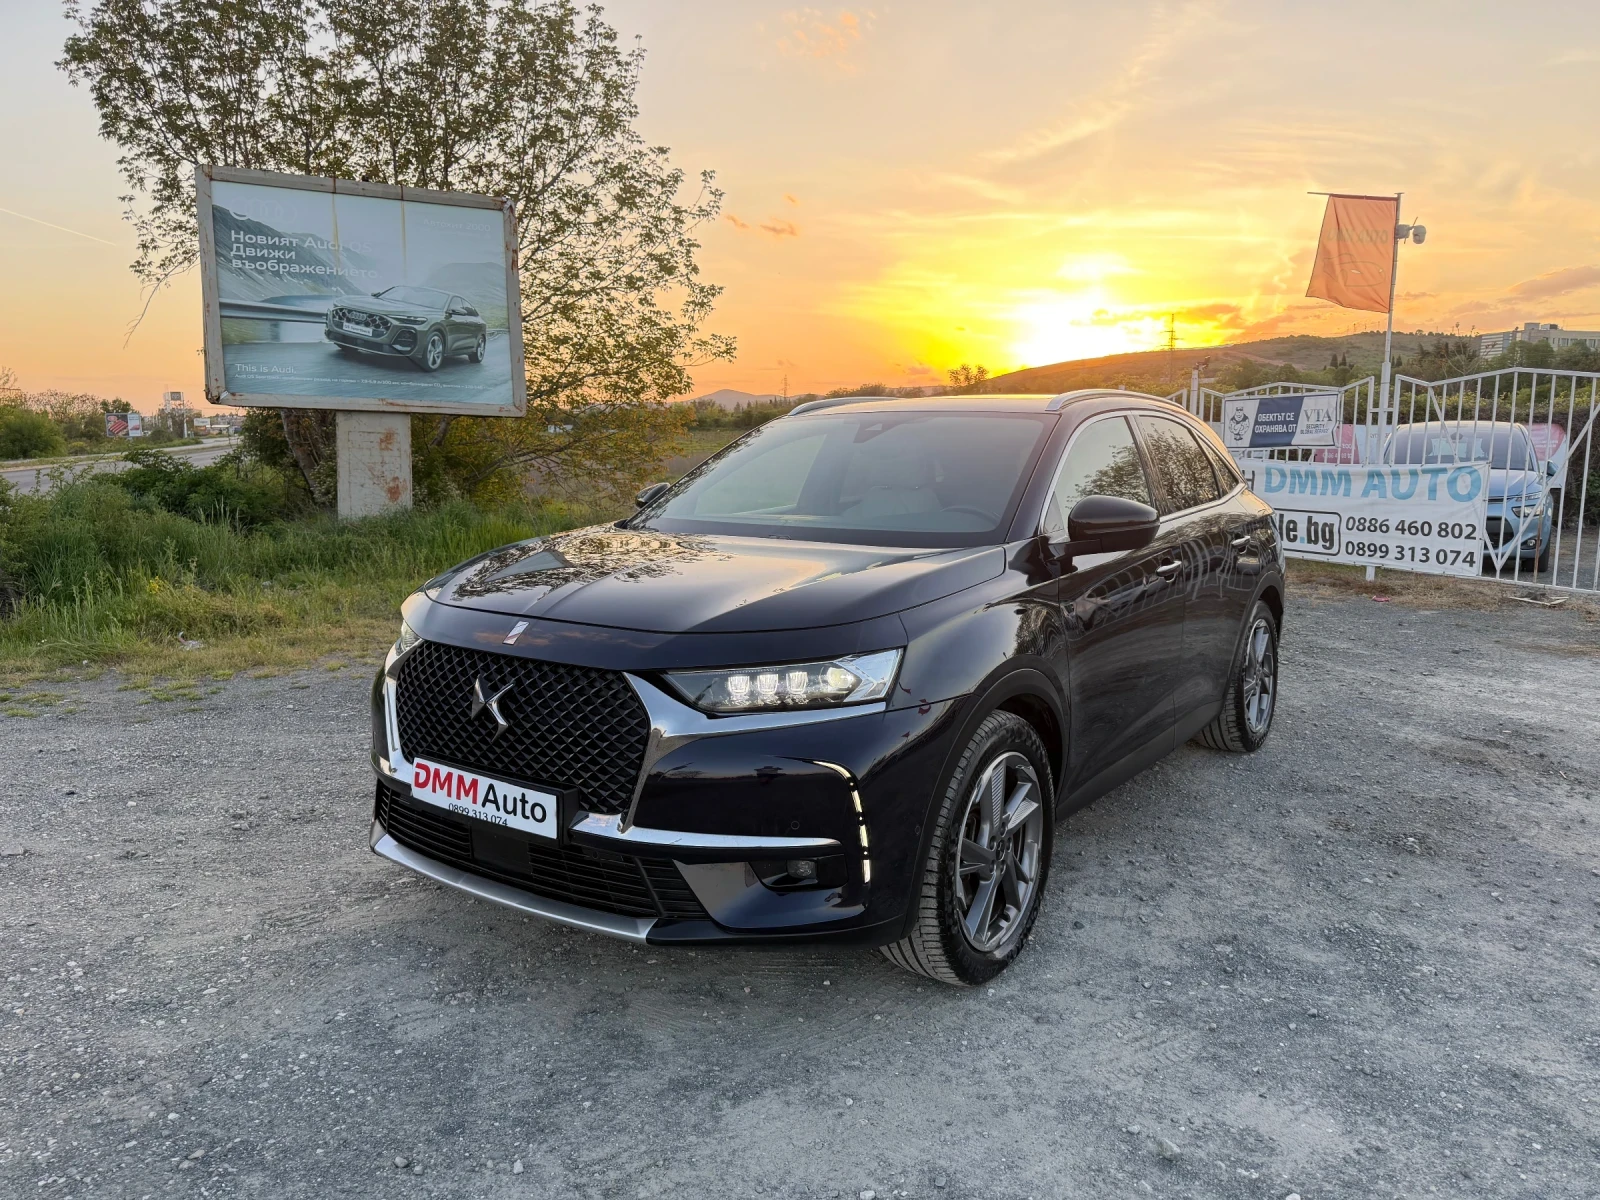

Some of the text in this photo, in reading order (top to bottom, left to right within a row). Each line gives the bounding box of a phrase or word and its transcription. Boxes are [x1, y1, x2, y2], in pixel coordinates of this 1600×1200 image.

[465, 222, 491, 232] 2000
[231, 230, 299, 247] Новият
[230, 243, 296, 260] Движи
[234, 363, 297, 374] This is Audi.
[1257, 412, 1295, 422] ОБЕКТЪТ СЕ
[1303, 409, 1332, 422] VTA
[1254, 424, 1297, 433] ОХРАНЯВА ОТ
[1264, 465, 1352, 497] DMM
[1361, 465, 1482, 502] AUTO
[1345, 515, 1477, 540] 0886 460 802
[1345, 540, 1476, 567] 0899 313 074
[448, 803, 508, 827] 0899 313 074
